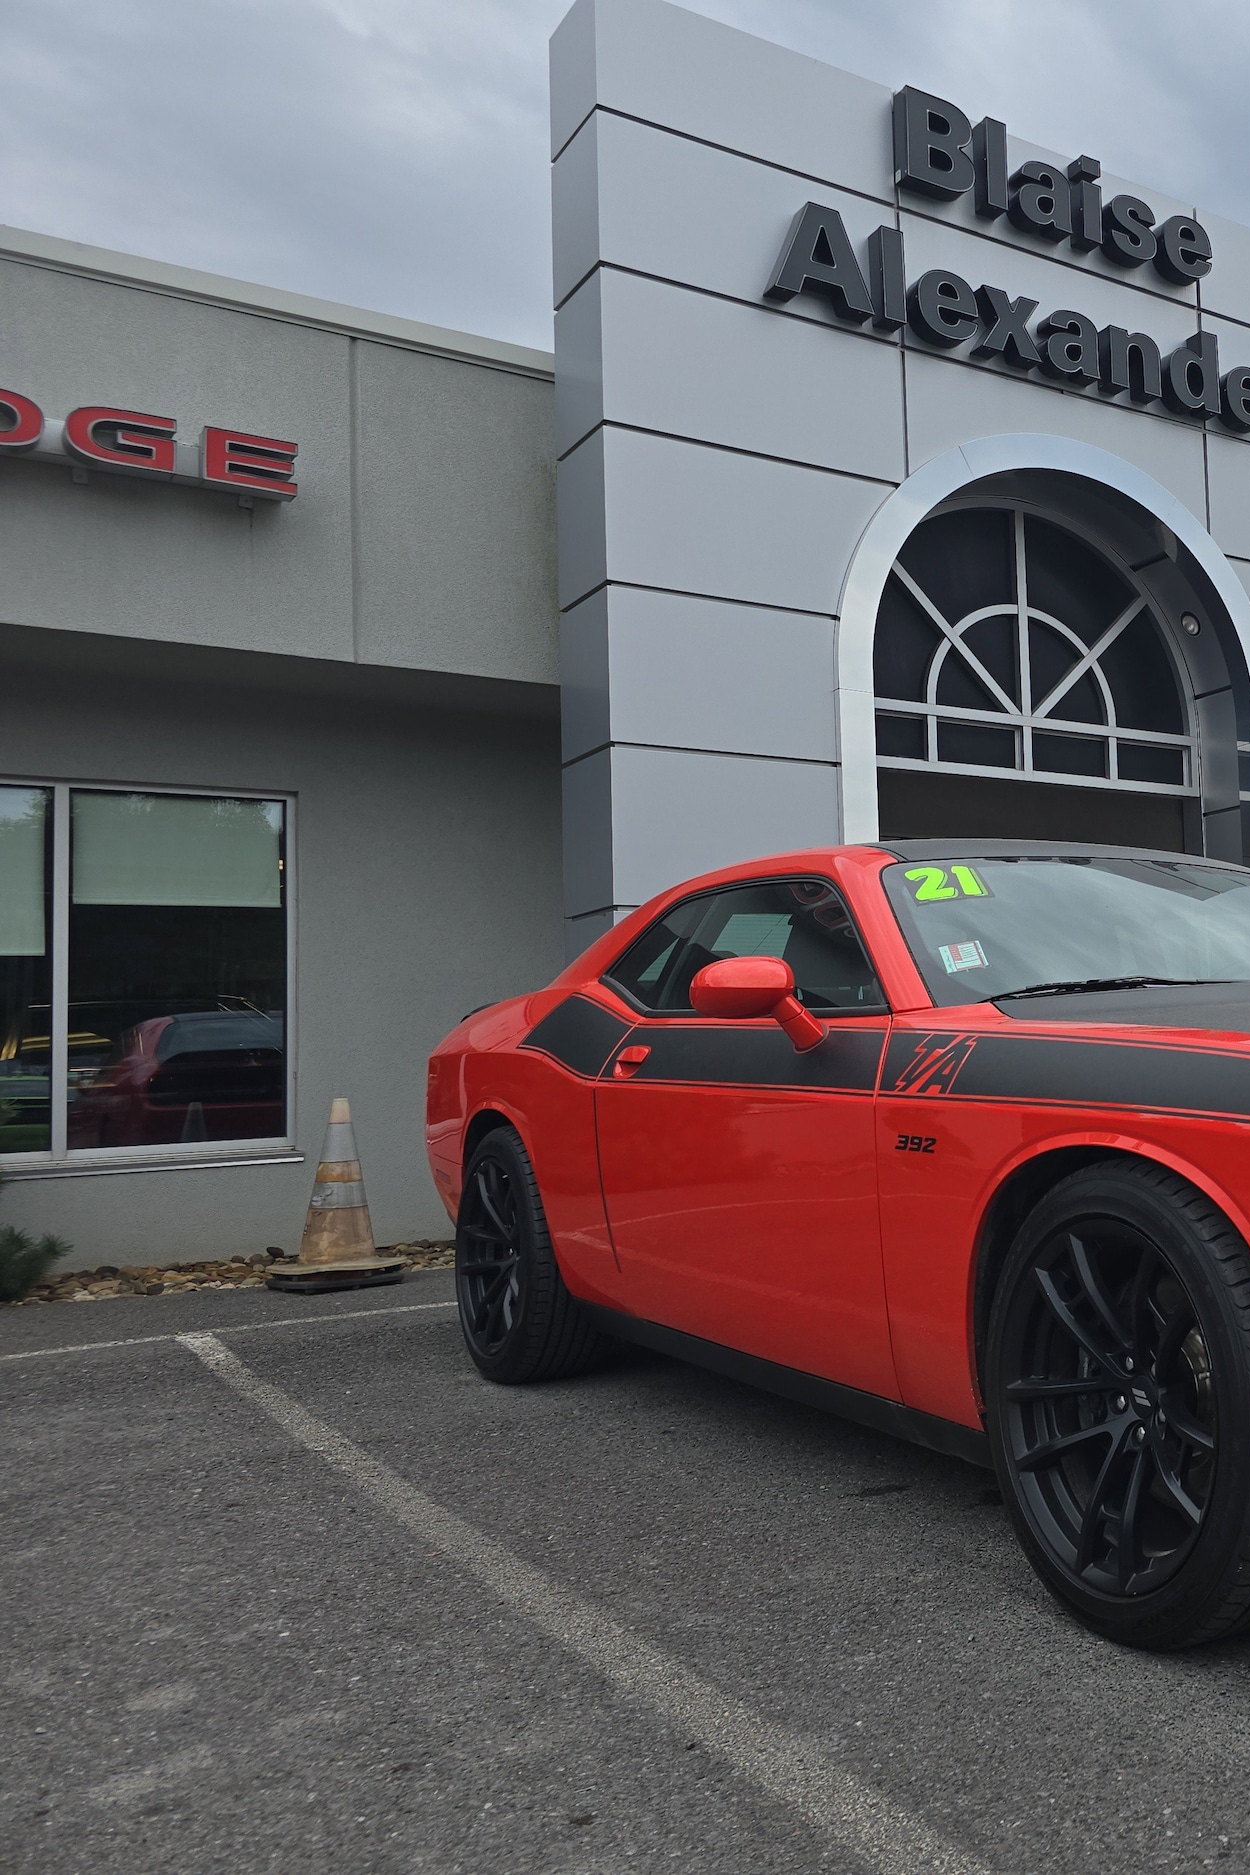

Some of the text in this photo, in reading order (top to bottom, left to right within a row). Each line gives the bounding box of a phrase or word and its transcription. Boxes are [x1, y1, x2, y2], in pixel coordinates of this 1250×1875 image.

[893, 85, 1212, 286] Blaise
[904, 865, 988, 902] 21
[895, 1134, 937, 1154] 392
